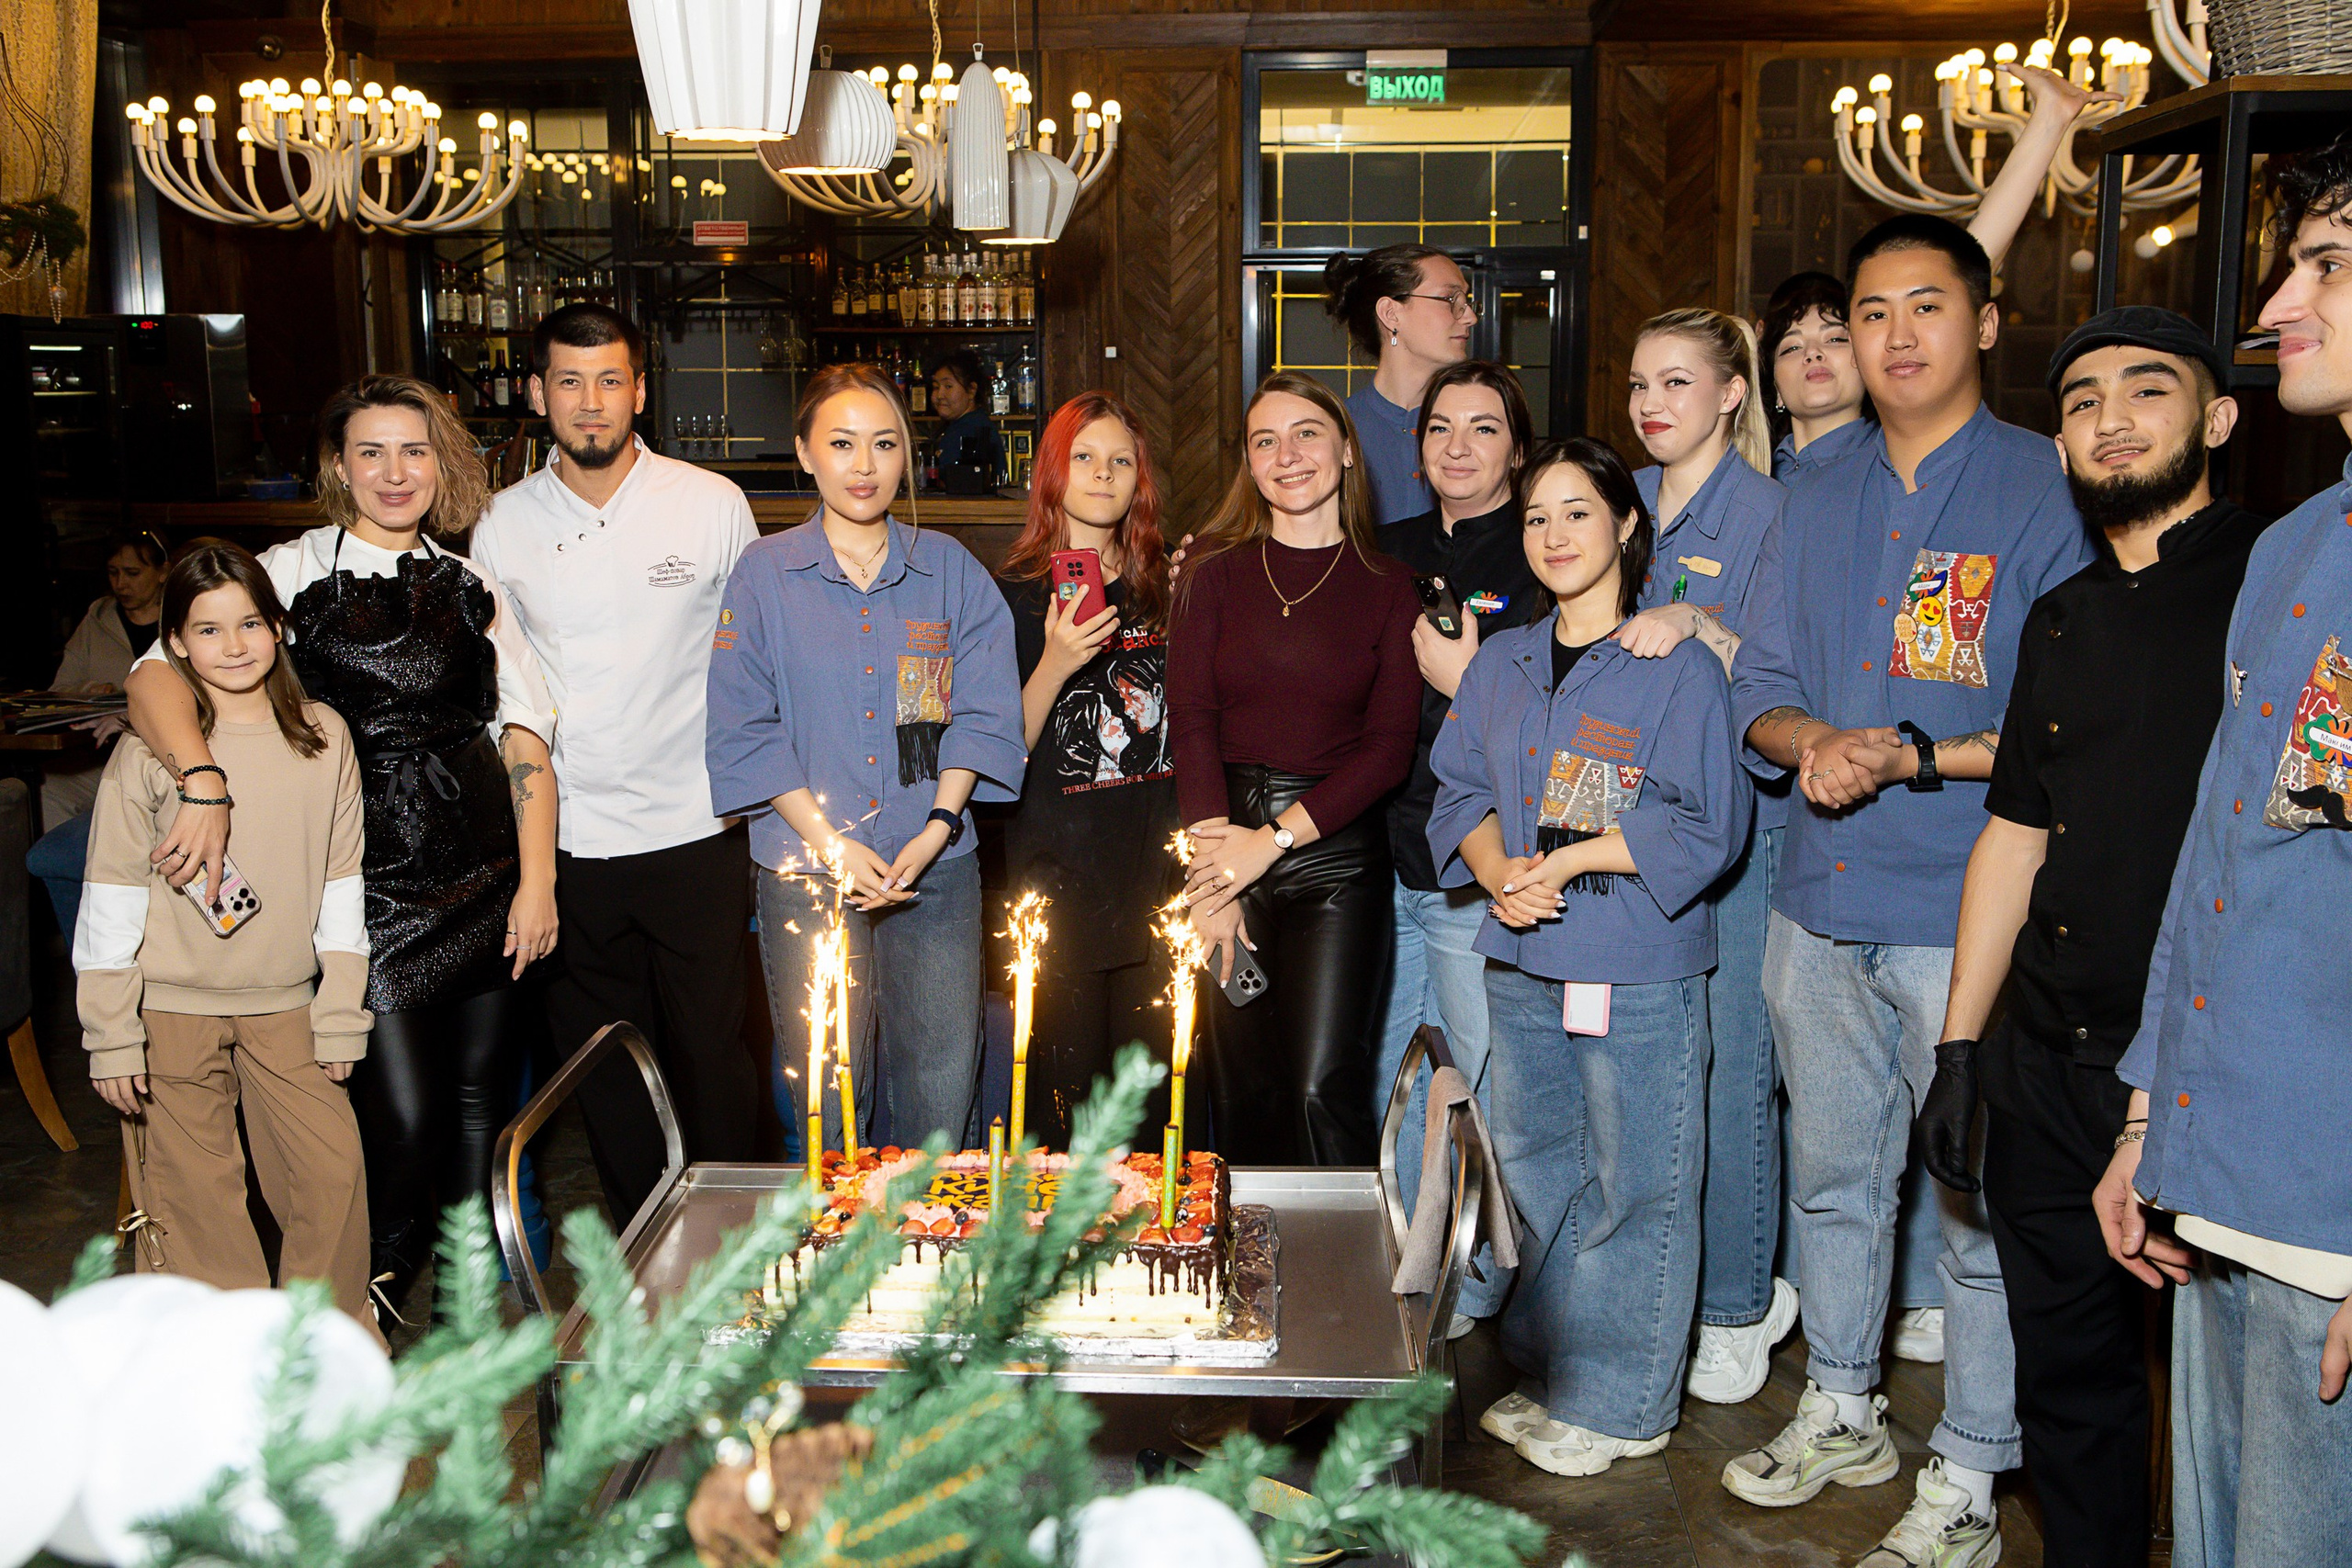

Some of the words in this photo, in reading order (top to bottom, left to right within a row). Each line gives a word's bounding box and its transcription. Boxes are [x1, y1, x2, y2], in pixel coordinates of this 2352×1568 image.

[1369, 75, 1445, 103] ВЫХОД
[1061, 783, 1091, 795] THREE
[1091, 779, 1125, 790] CHEERS
[1125, 774, 1144, 784] FOR
